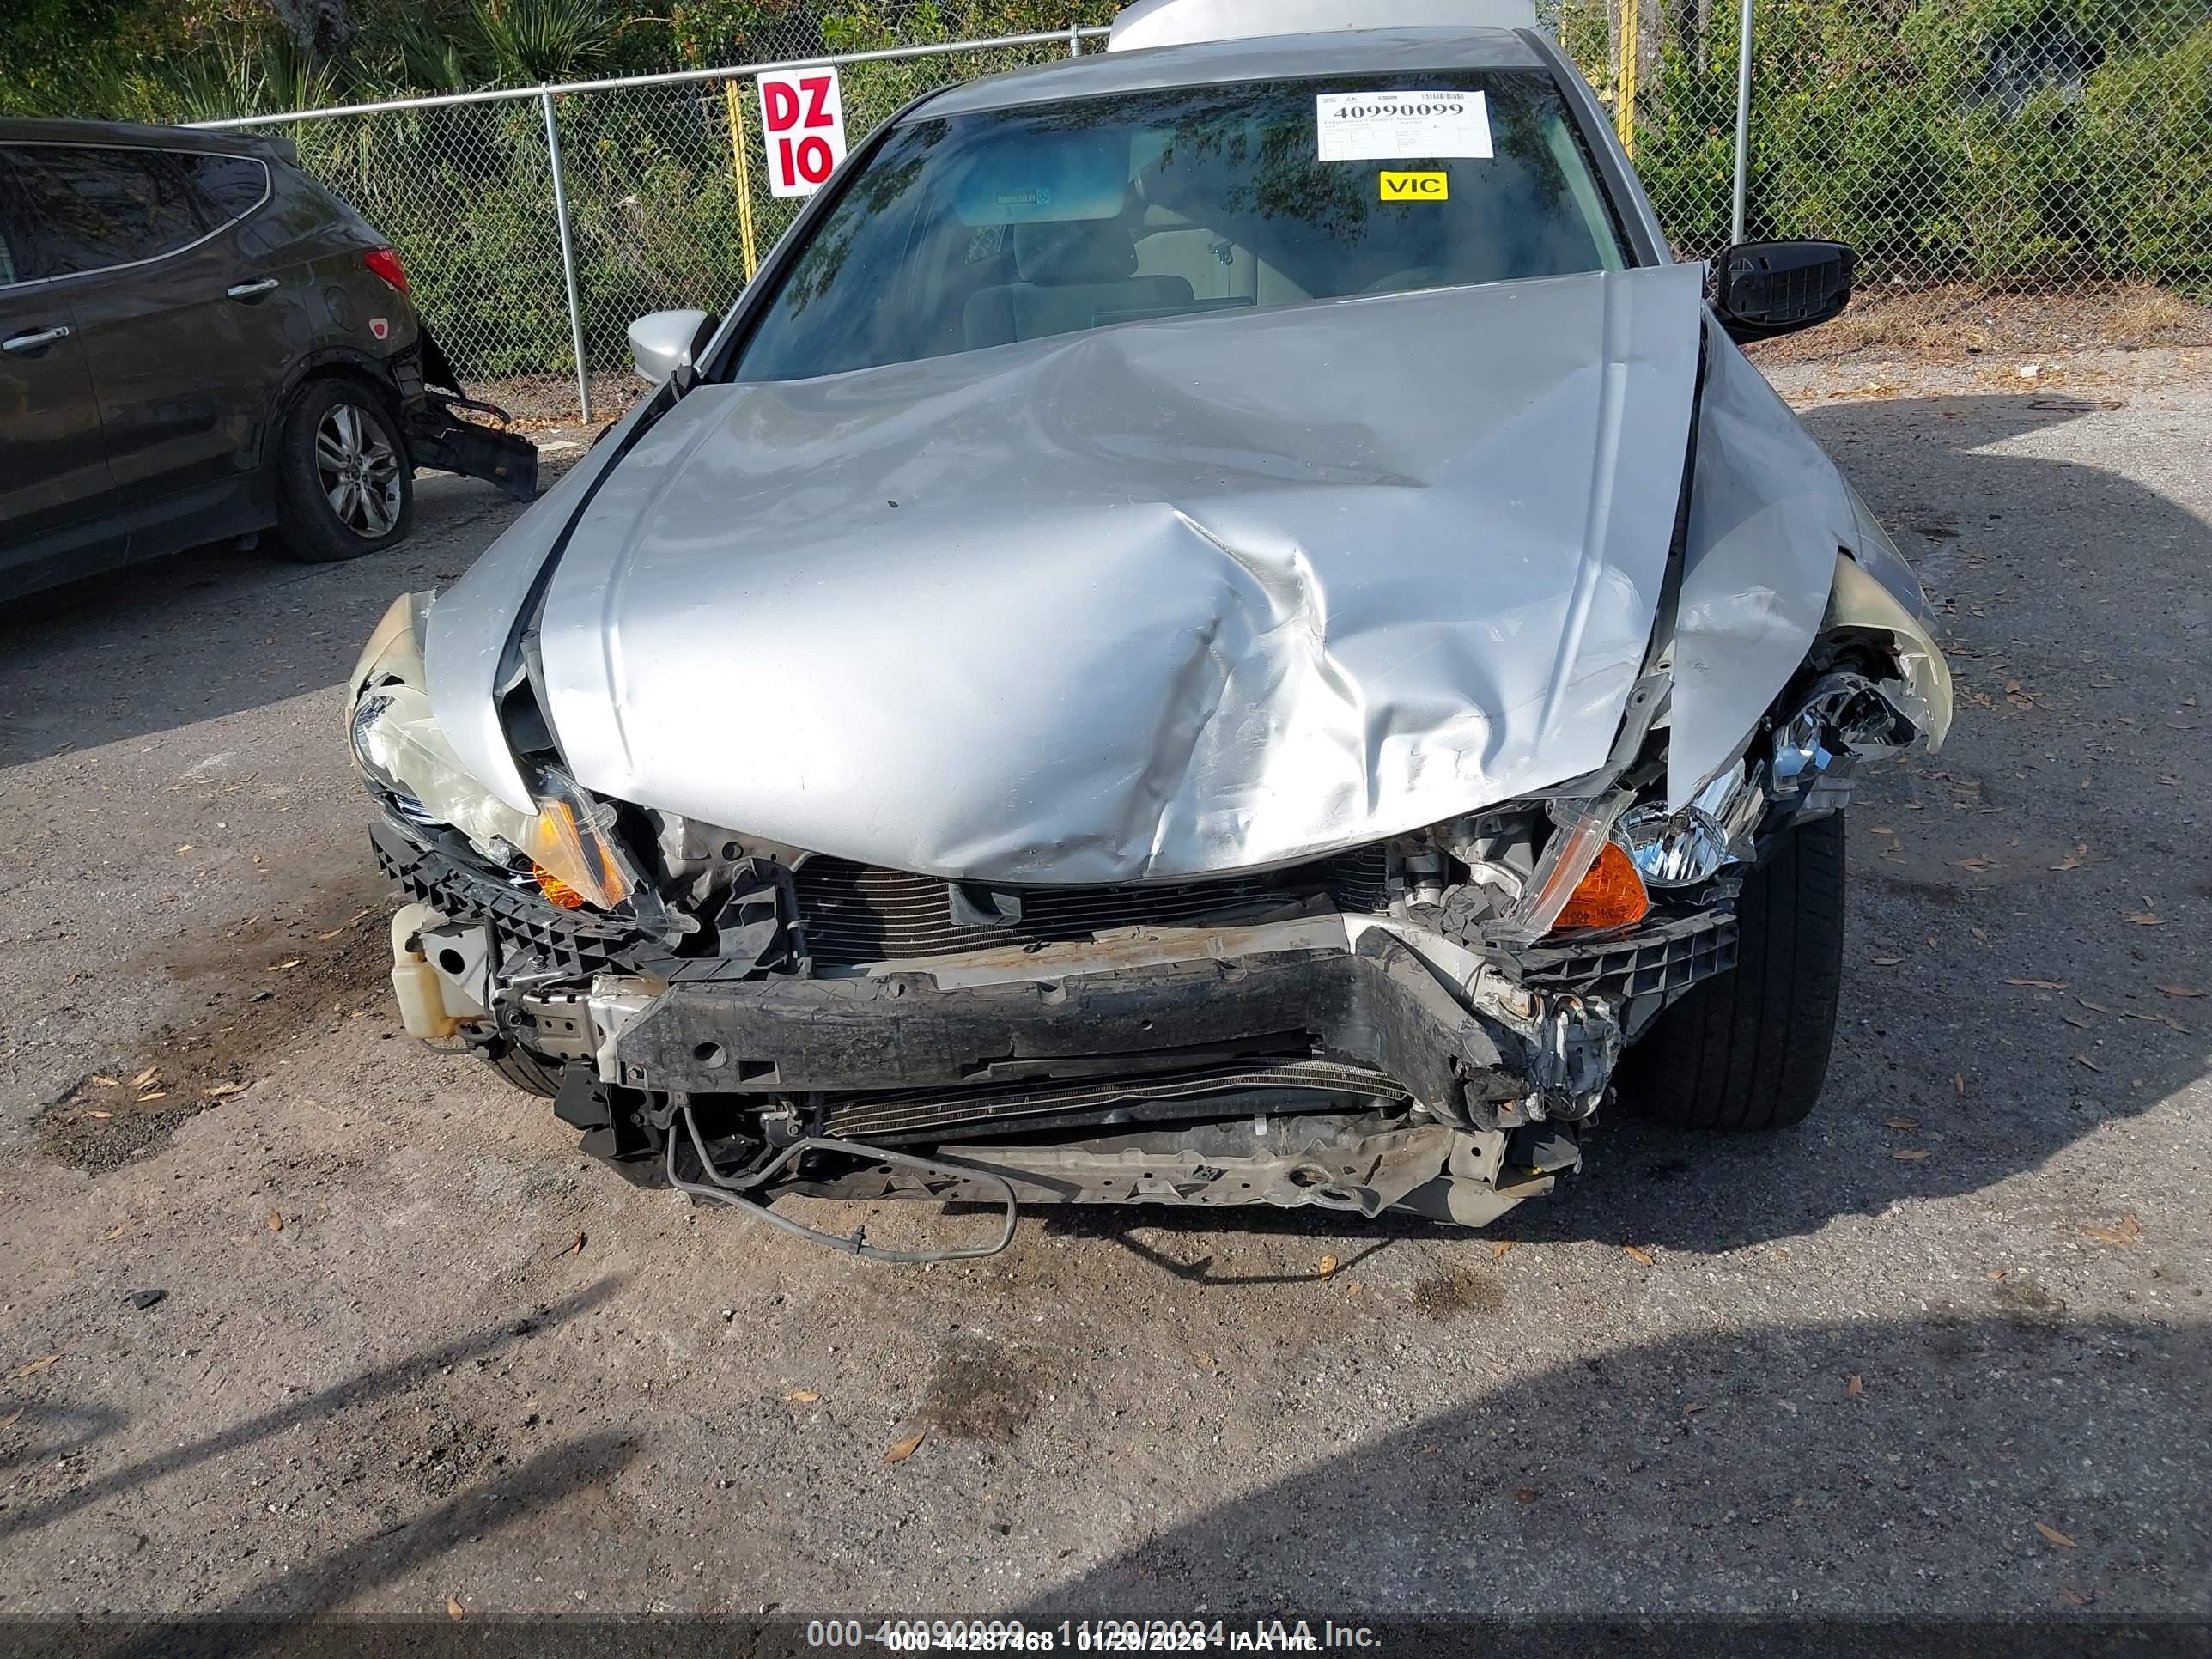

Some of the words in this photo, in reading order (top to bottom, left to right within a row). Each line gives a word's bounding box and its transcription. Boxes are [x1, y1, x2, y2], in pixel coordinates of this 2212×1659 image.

[763, 76, 834, 131] DZ
[1334, 103, 1464, 119] 40990099
[1386, 179, 1442, 193] VIC
